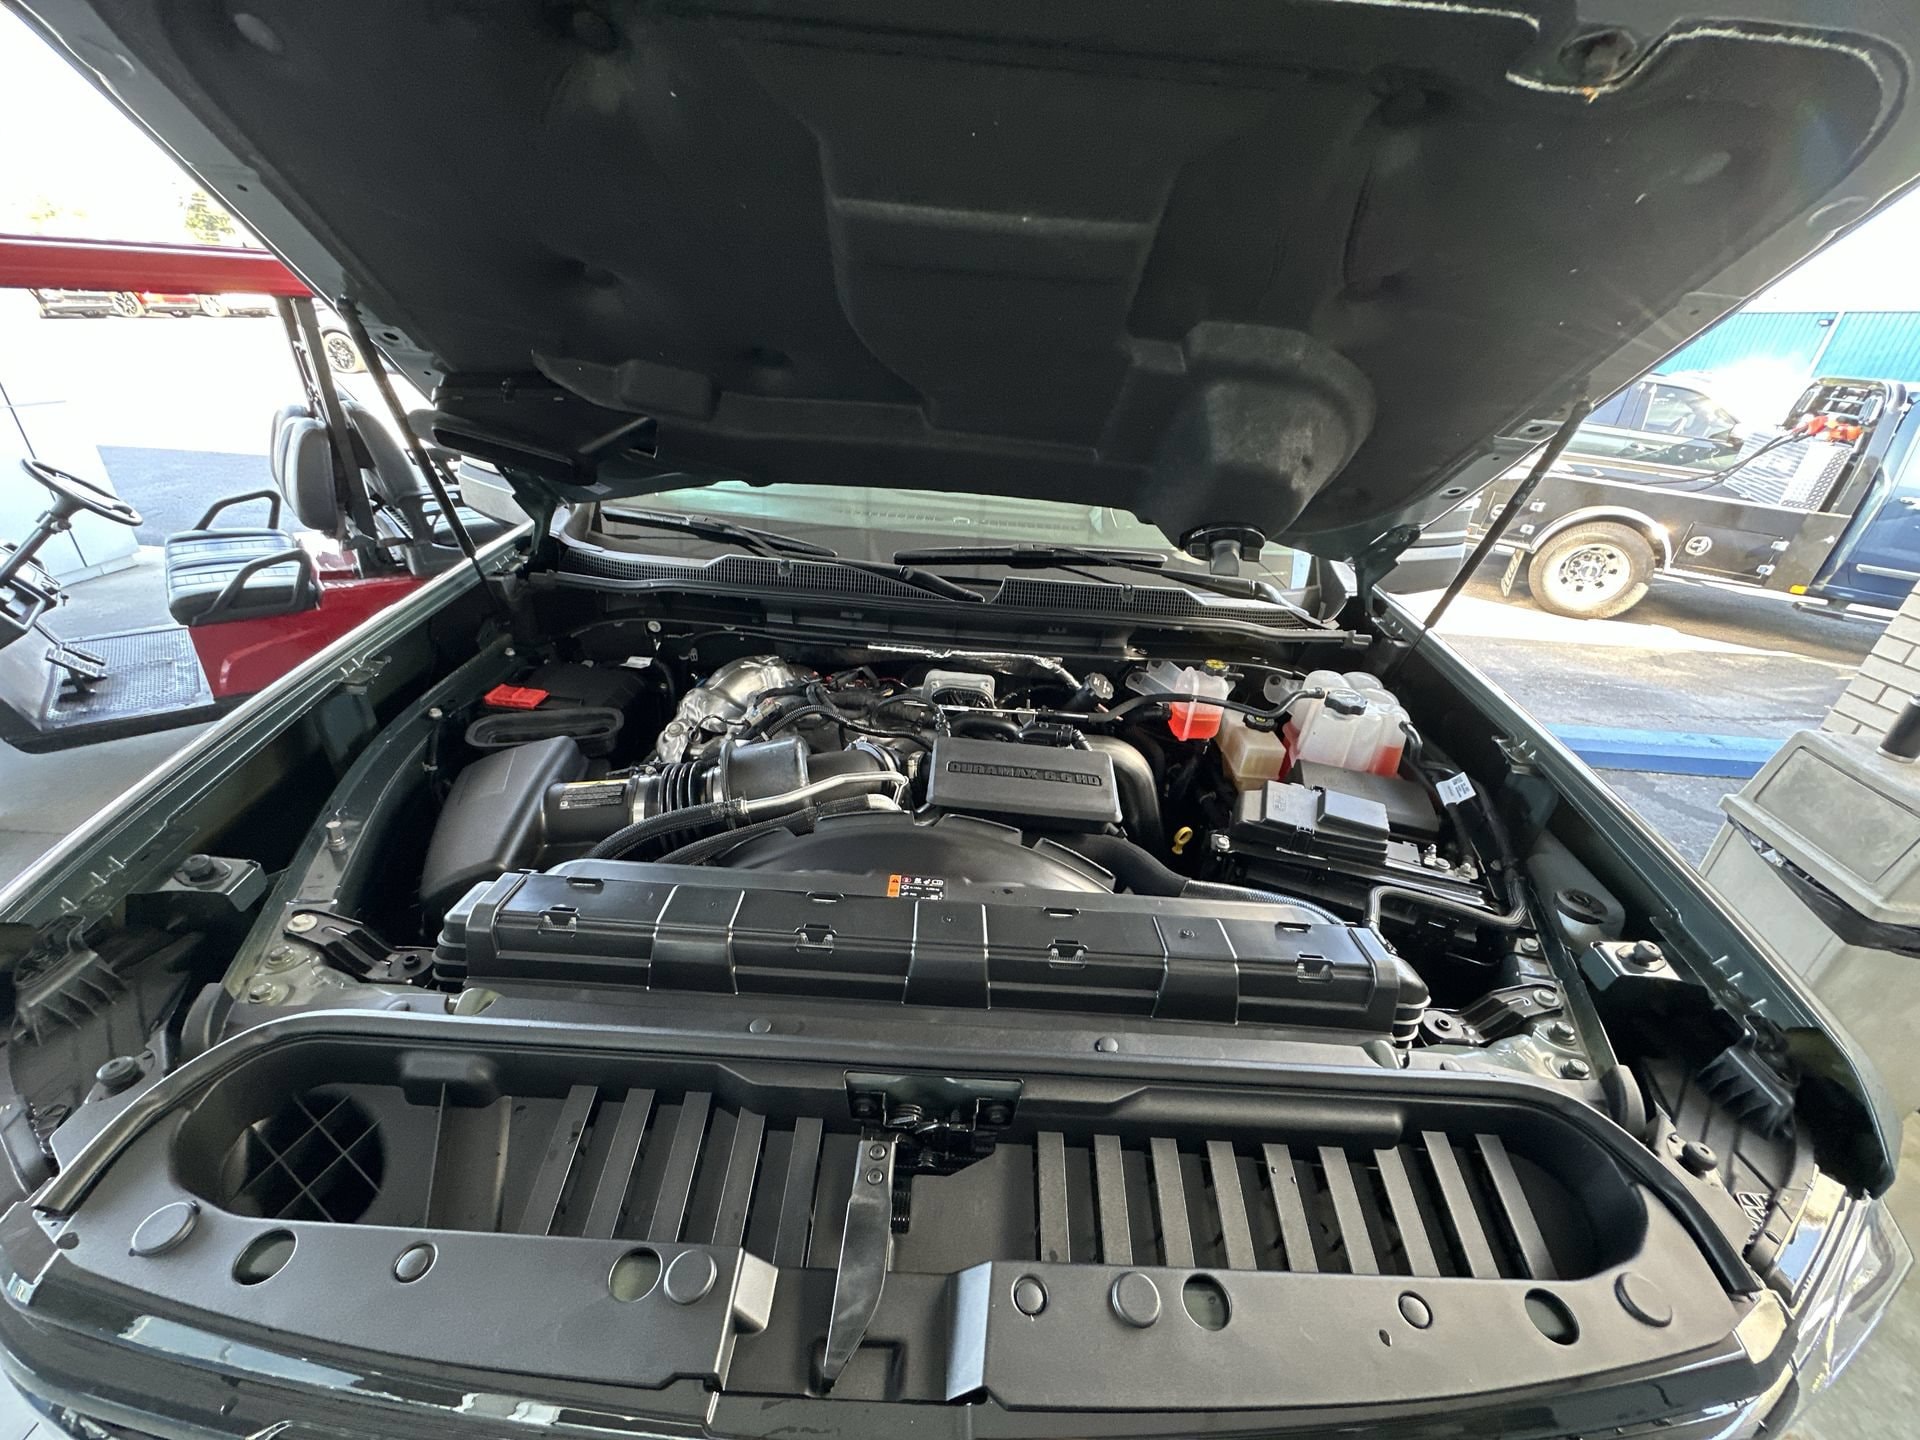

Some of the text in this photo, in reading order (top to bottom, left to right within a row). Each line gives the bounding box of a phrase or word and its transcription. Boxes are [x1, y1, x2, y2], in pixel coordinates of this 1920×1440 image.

[949, 761, 1101, 786] DURAMAX 6.6 HD
